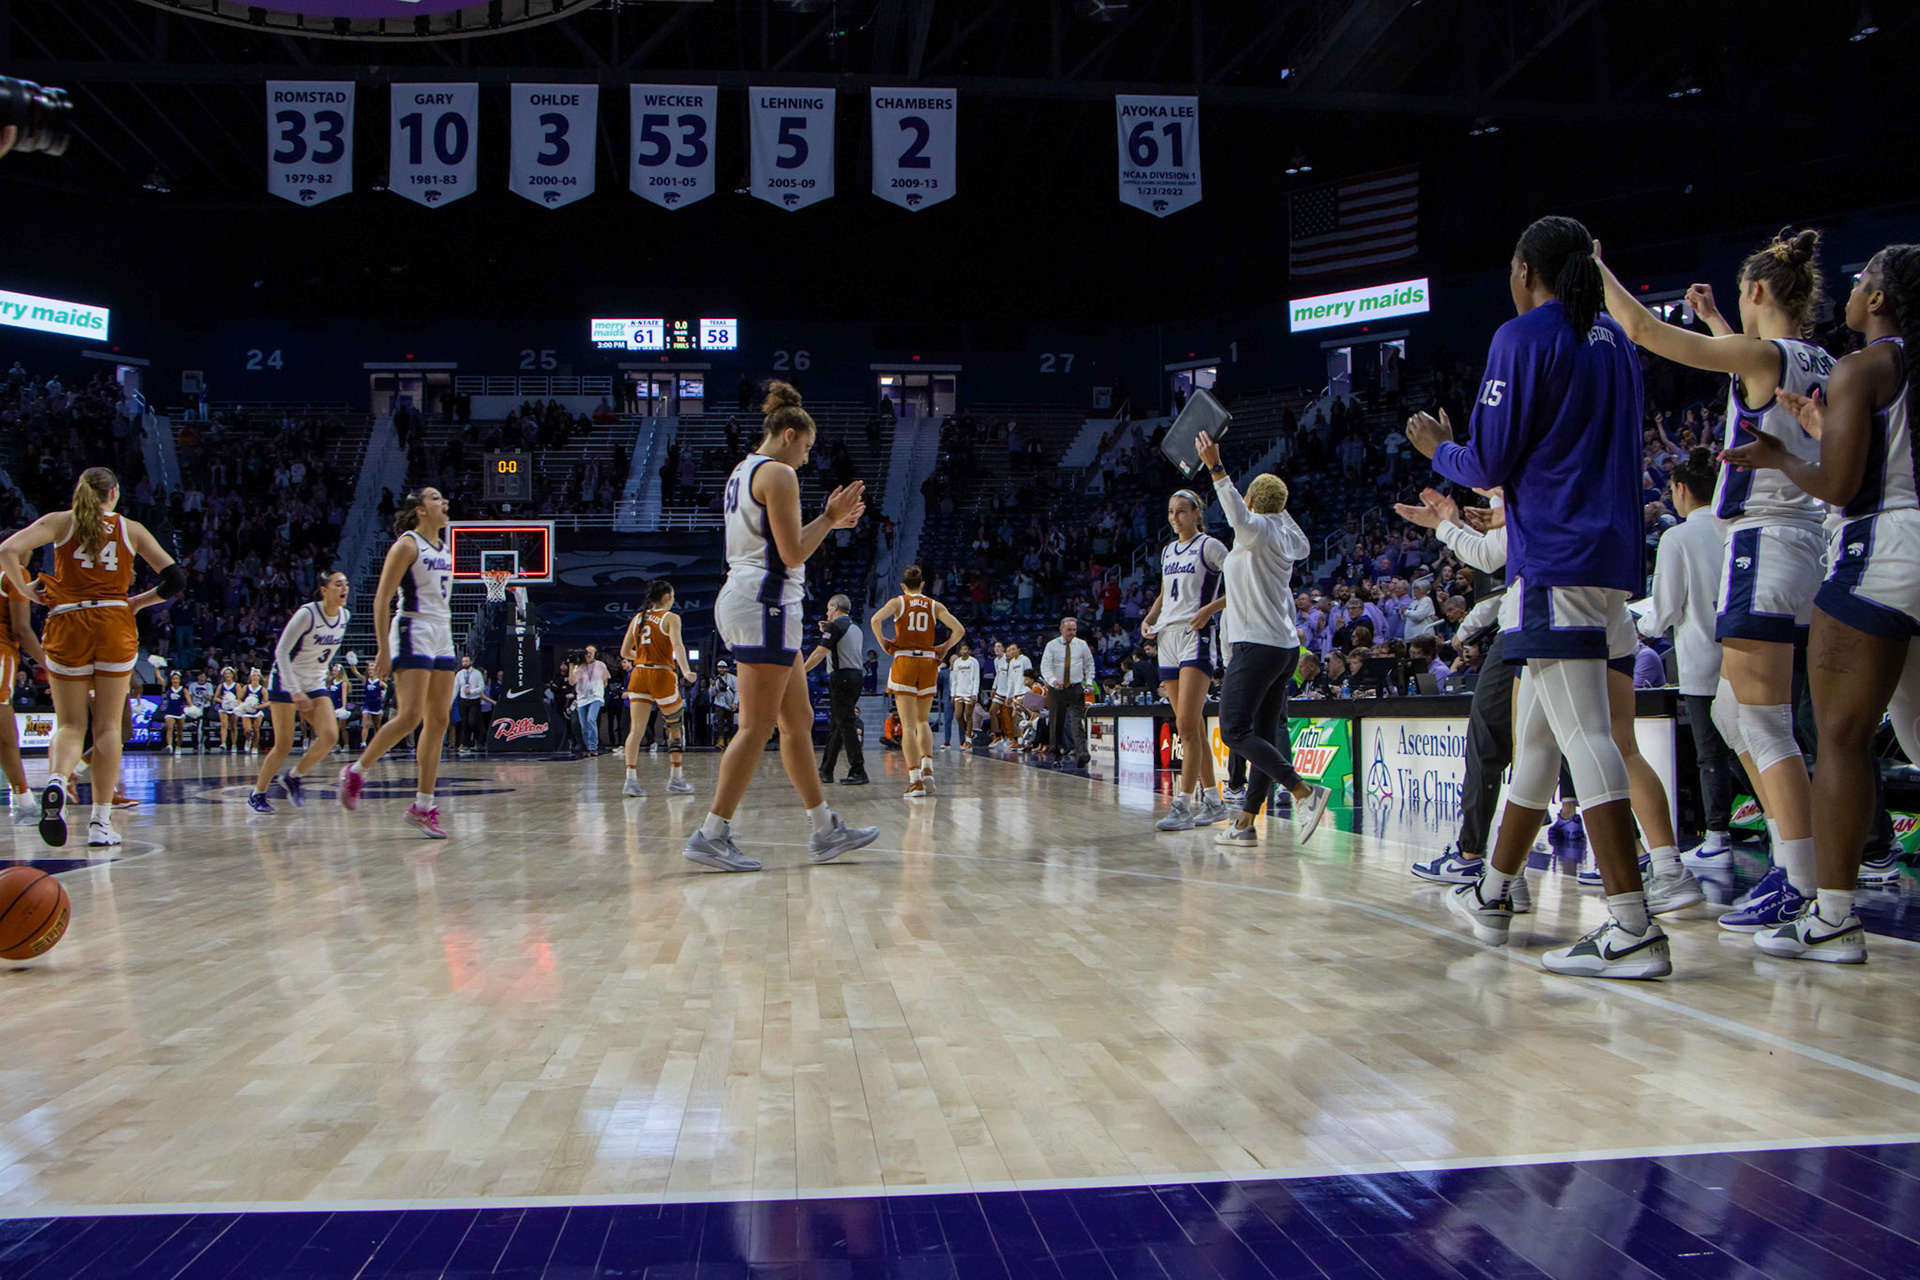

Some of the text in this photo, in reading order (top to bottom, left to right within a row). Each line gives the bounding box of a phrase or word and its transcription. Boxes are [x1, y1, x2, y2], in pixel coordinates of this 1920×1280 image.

[274, 91, 347, 103] ROMSTAD
[414, 93, 454, 106] GARY
[529, 94, 579, 106] OHLDE
[644, 95, 704, 107] WECKER
[761, 97, 824, 110] LEHNING
[875, 97, 953, 110] CHAMBERS
[1121, 105, 1194, 118] AYOKA LEE
[273, 110, 345, 164] 33
[399, 112, 469, 166] 10
[536, 112, 571, 166] 3
[638, 113, 709, 168] 53
[775, 116, 809, 169] 5
[898, 116, 931, 169] 2
[1128, 121, 1184, 168] 61
[284, 174, 333, 184] 1979-82
[409, 174, 458, 185] 1981-83
[528, 175, 577, 186] 2000-04
[648, 177, 697, 187] 2001-05
[767, 178, 816, 189] 2005-09
[890, 178, 938, 189] 2009-13
[1123, 171, 1147, 180] NCAA
[1149, 171, 1189, 180] DIVISION
[1138, 187, 1183, 196] 1/23/2022
[1294, 286, 1425, 322] merry maids
[31, 305, 103, 330] maids
[593, 328, 625, 336] maids
[595, 322, 627, 330] merry
[633, 329, 653, 344] 61
[707, 329, 729, 344] 58
[246, 348, 284, 371] 24
[519, 349, 558, 371] 25
[773, 350, 811, 372] 26
[1039, 352, 1075, 373] 27
[1479, 379, 1507, 407] 15
[73, 541, 118, 571] 44
[1171, 578, 1180, 602] 4
[907, 611, 929, 632] 10
[641, 625, 652, 645] 2
[317, 648, 331, 664] 3
[1397, 768, 1463, 806] Via Chris
